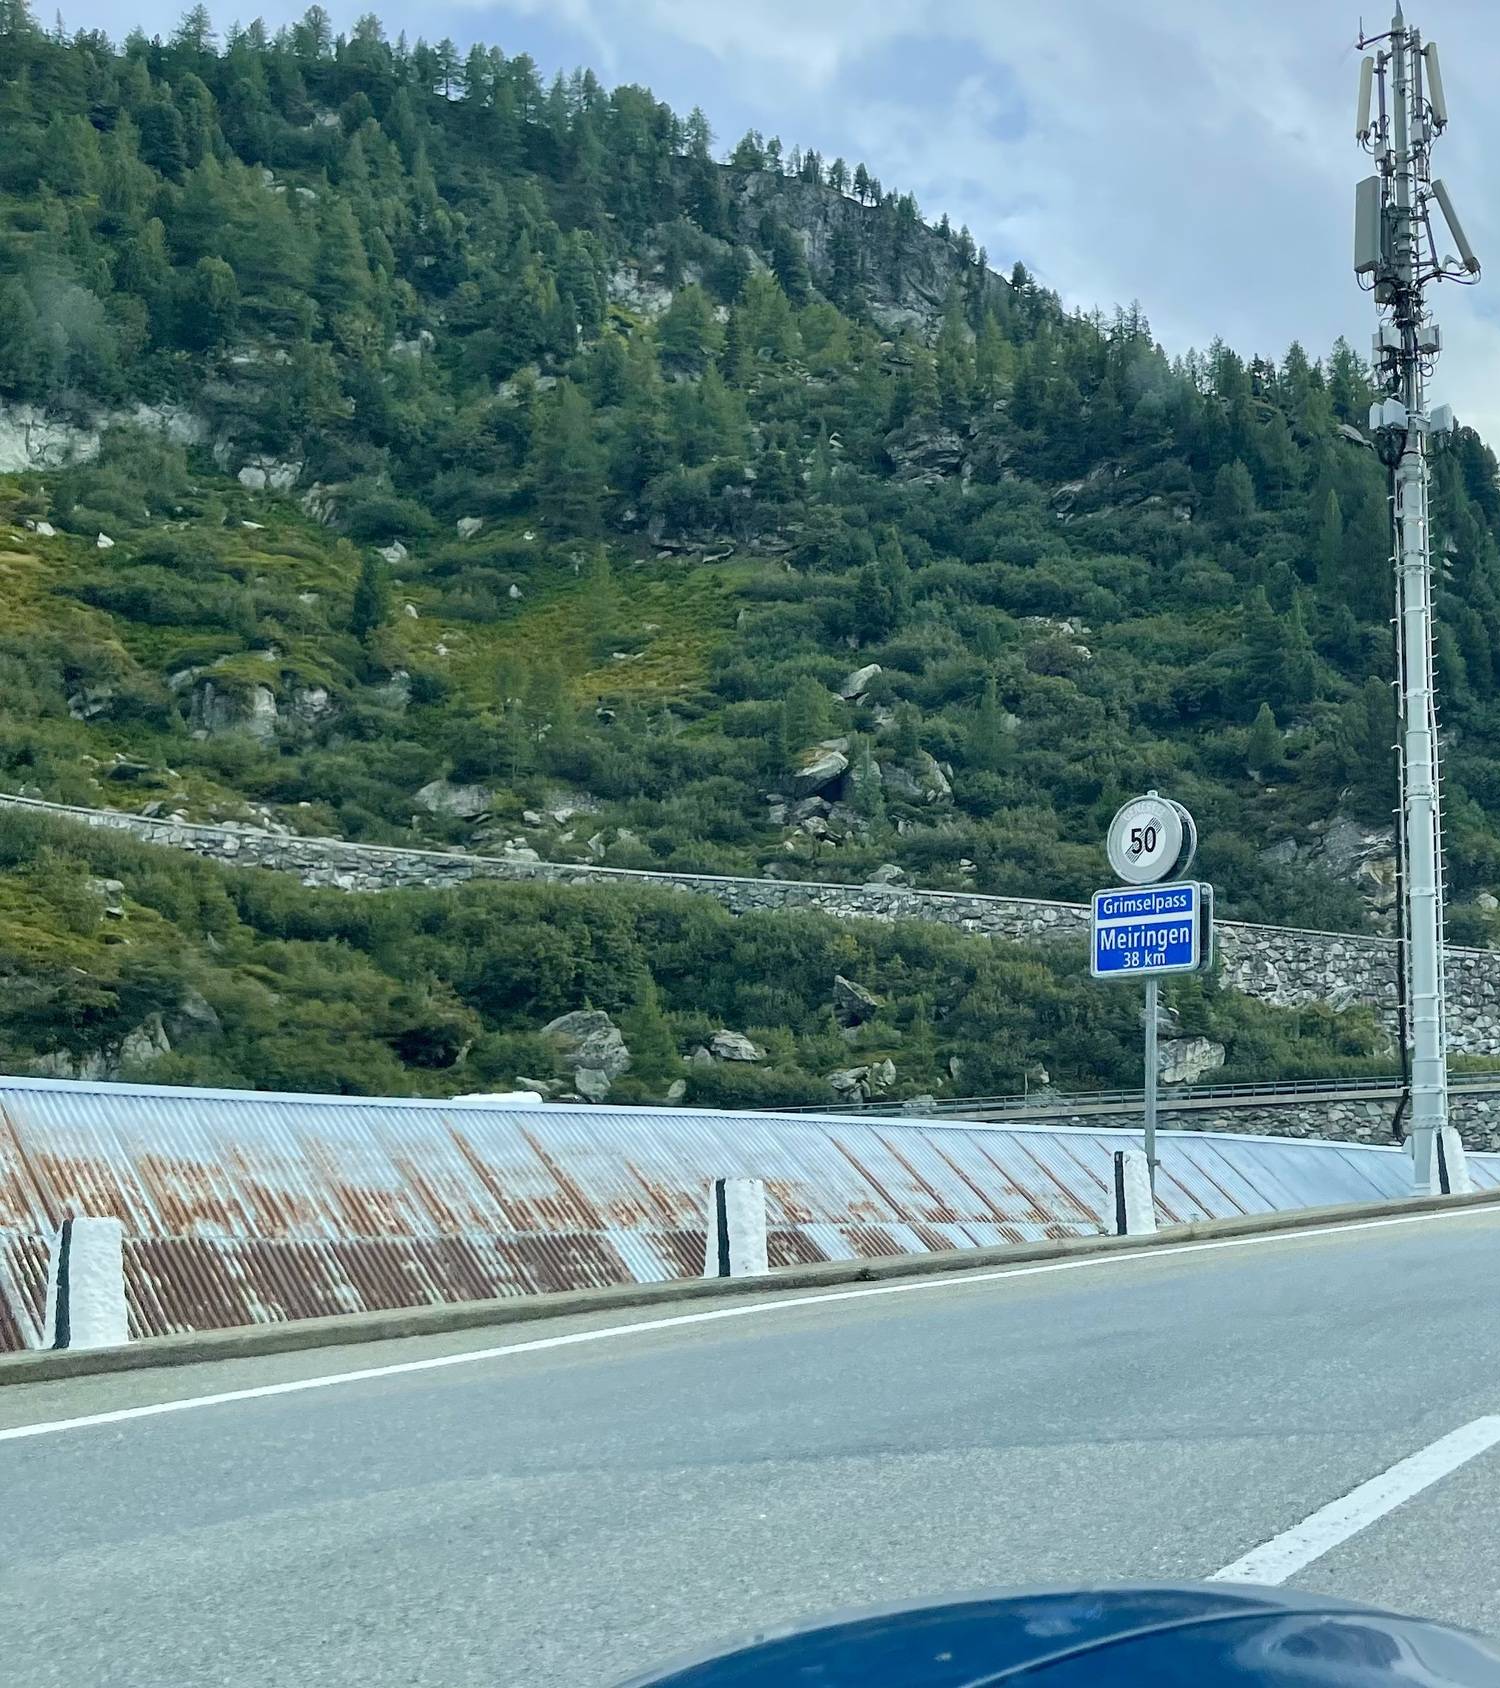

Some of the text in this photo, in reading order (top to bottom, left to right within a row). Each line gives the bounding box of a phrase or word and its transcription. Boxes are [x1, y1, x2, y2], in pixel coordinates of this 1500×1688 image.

[1131, 826, 1157, 854] 50
[1103, 894, 1187, 914] Grimselpass
[1100, 926, 1189, 951] Meiringen
[1123, 950, 1166, 968] 38 km
